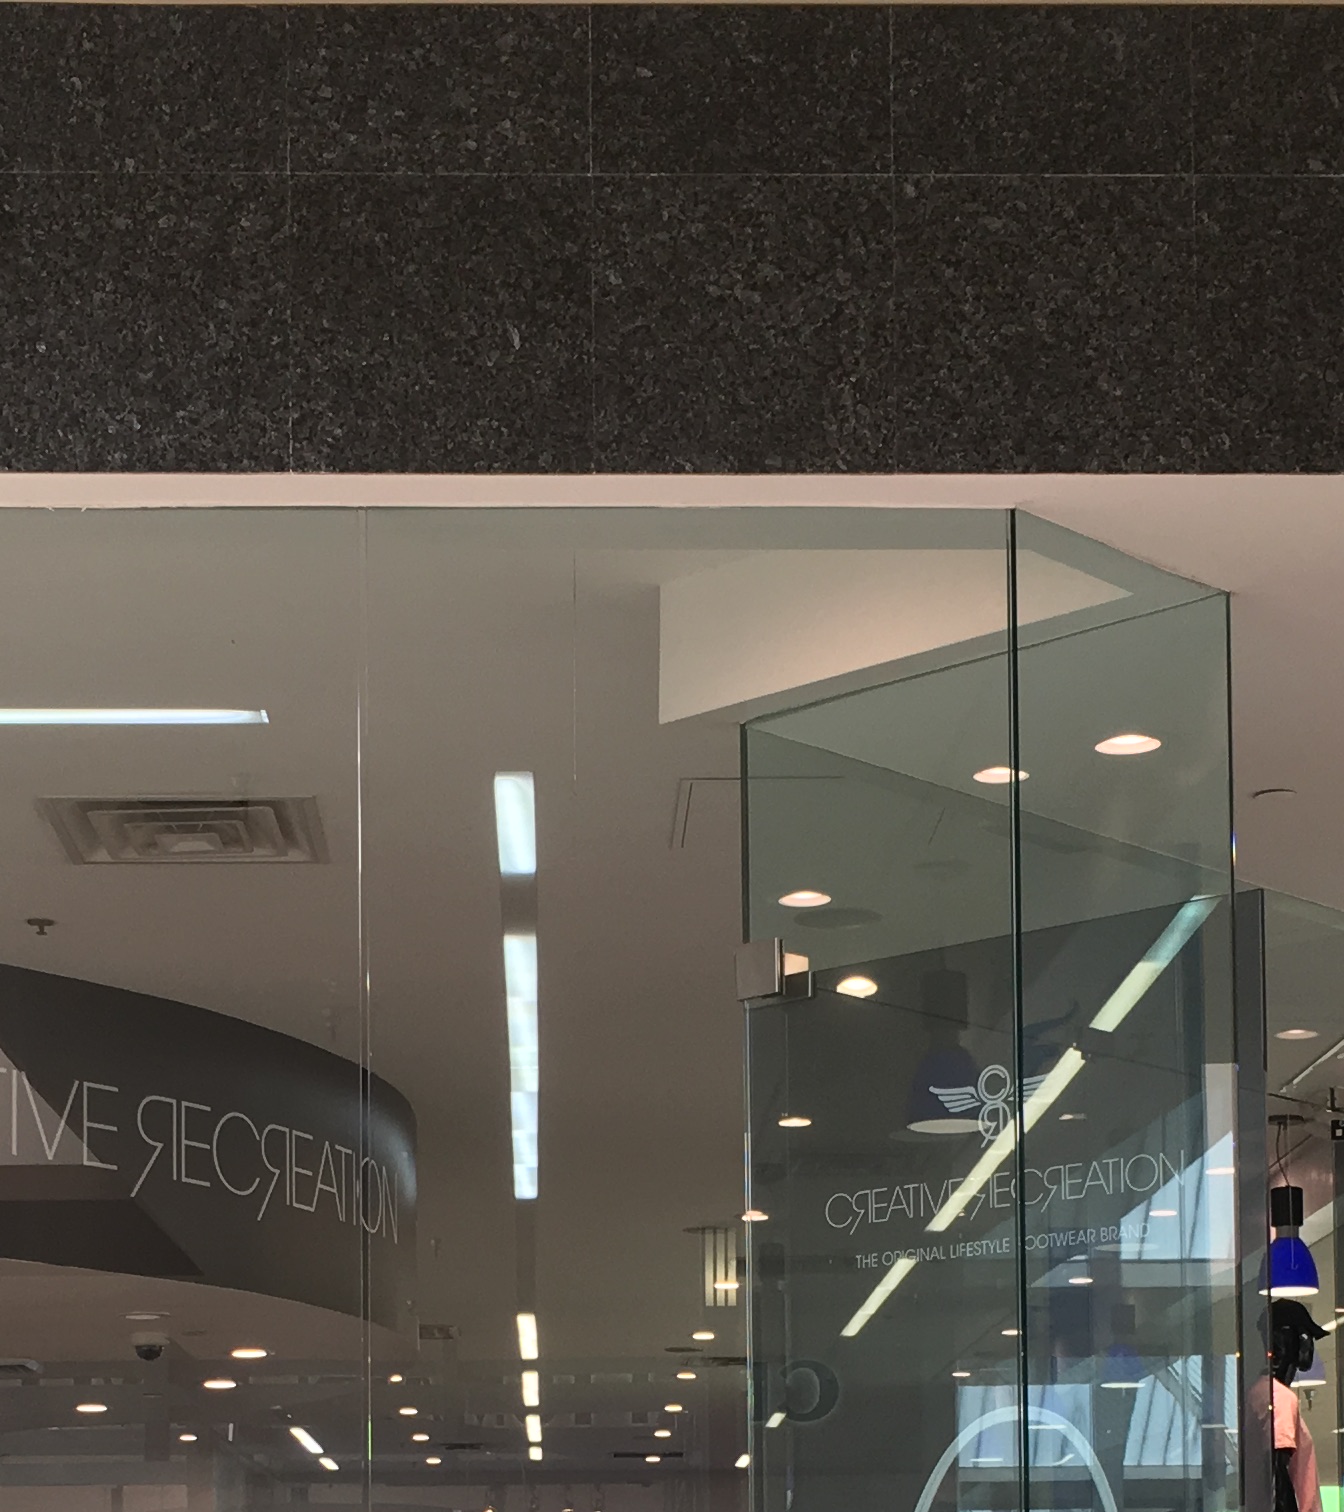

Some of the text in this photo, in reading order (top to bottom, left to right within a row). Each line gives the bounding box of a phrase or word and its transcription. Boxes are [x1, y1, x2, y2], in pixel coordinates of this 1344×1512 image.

[131, 1094, 399, 1245] RECREATION
[856, 1253, 878, 1268] THE
[950, 1237, 1010, 1259] LIFESTYLE
[1022, 1228, 1096, 1251] OOTWEAR
[1101, 1222, 1151, 1242] BRAND
